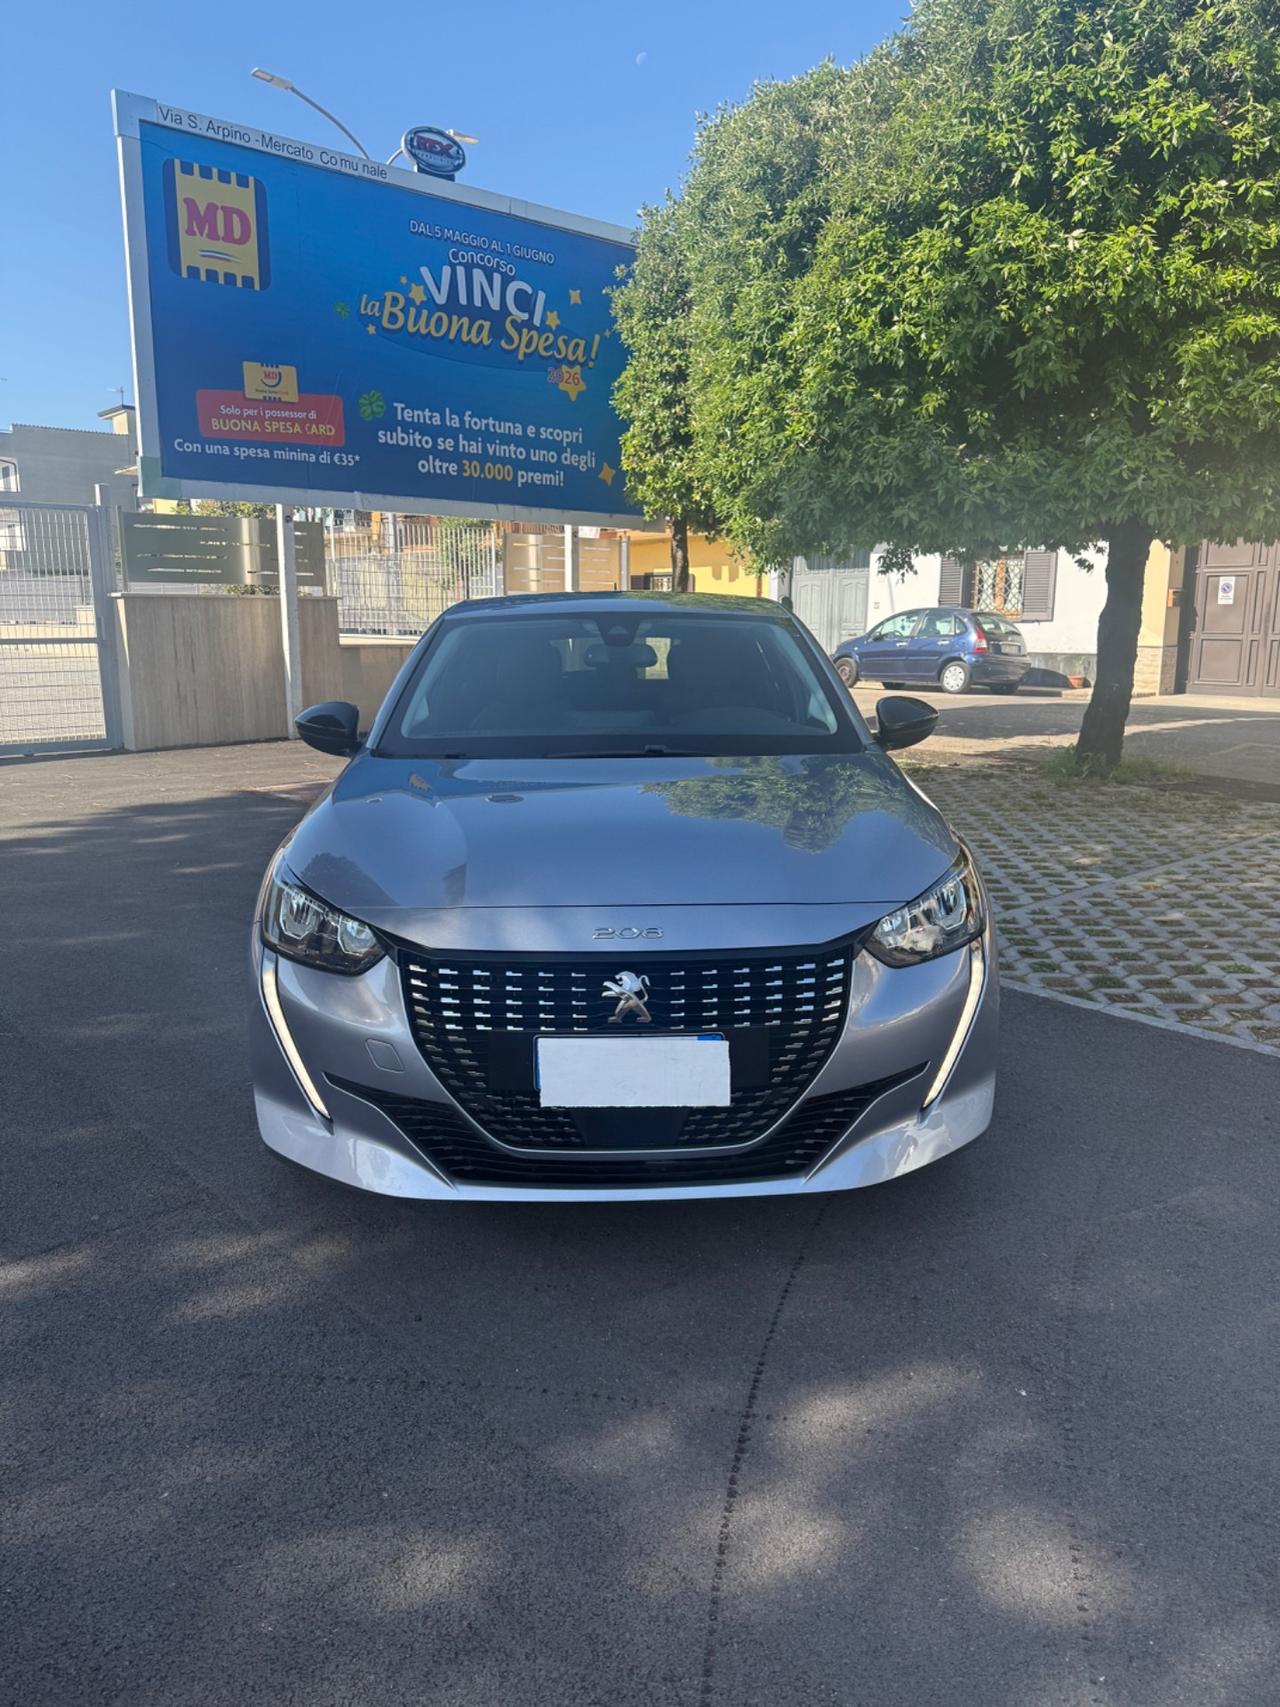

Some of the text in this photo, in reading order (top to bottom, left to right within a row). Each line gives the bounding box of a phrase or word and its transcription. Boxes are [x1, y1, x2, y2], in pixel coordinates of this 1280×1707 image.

[159, 106, 183, 125] Via
[187, 114, 202, 131] S.
[206, 120, 250, 144] Arpino
[183, 197, 252, 246] MD
[410, 220, 555, 264] DAL 5 MAGGIO AL 1 GIUGNO
[449, 249, 516, 276] Concorso
[419, 265, 546, 327] VINCI
[360, 291, 601, 369] la Buona Spesa!
[212, 418, 260, 433] BUONA
[265, 421, 302, 434] SPESA
[220, 405, 241, 415] Solo
[243, 408, 258, 419] per
[308, 411, 317, 420] di
[393, 402, 583, 447] Tenta la fortuna e scopri
[174, 439, 201, 453] Con
[206, 444, 230, 455] una
[233, 446, 270, 460] spesa
[319, 450, 331, 464] di
[378, 427, 596, 472] subito se hai vinto uno degli
[417, 455, 564, 488] oltre 30.000 premi!
[592, 927, 664, 940] 208
